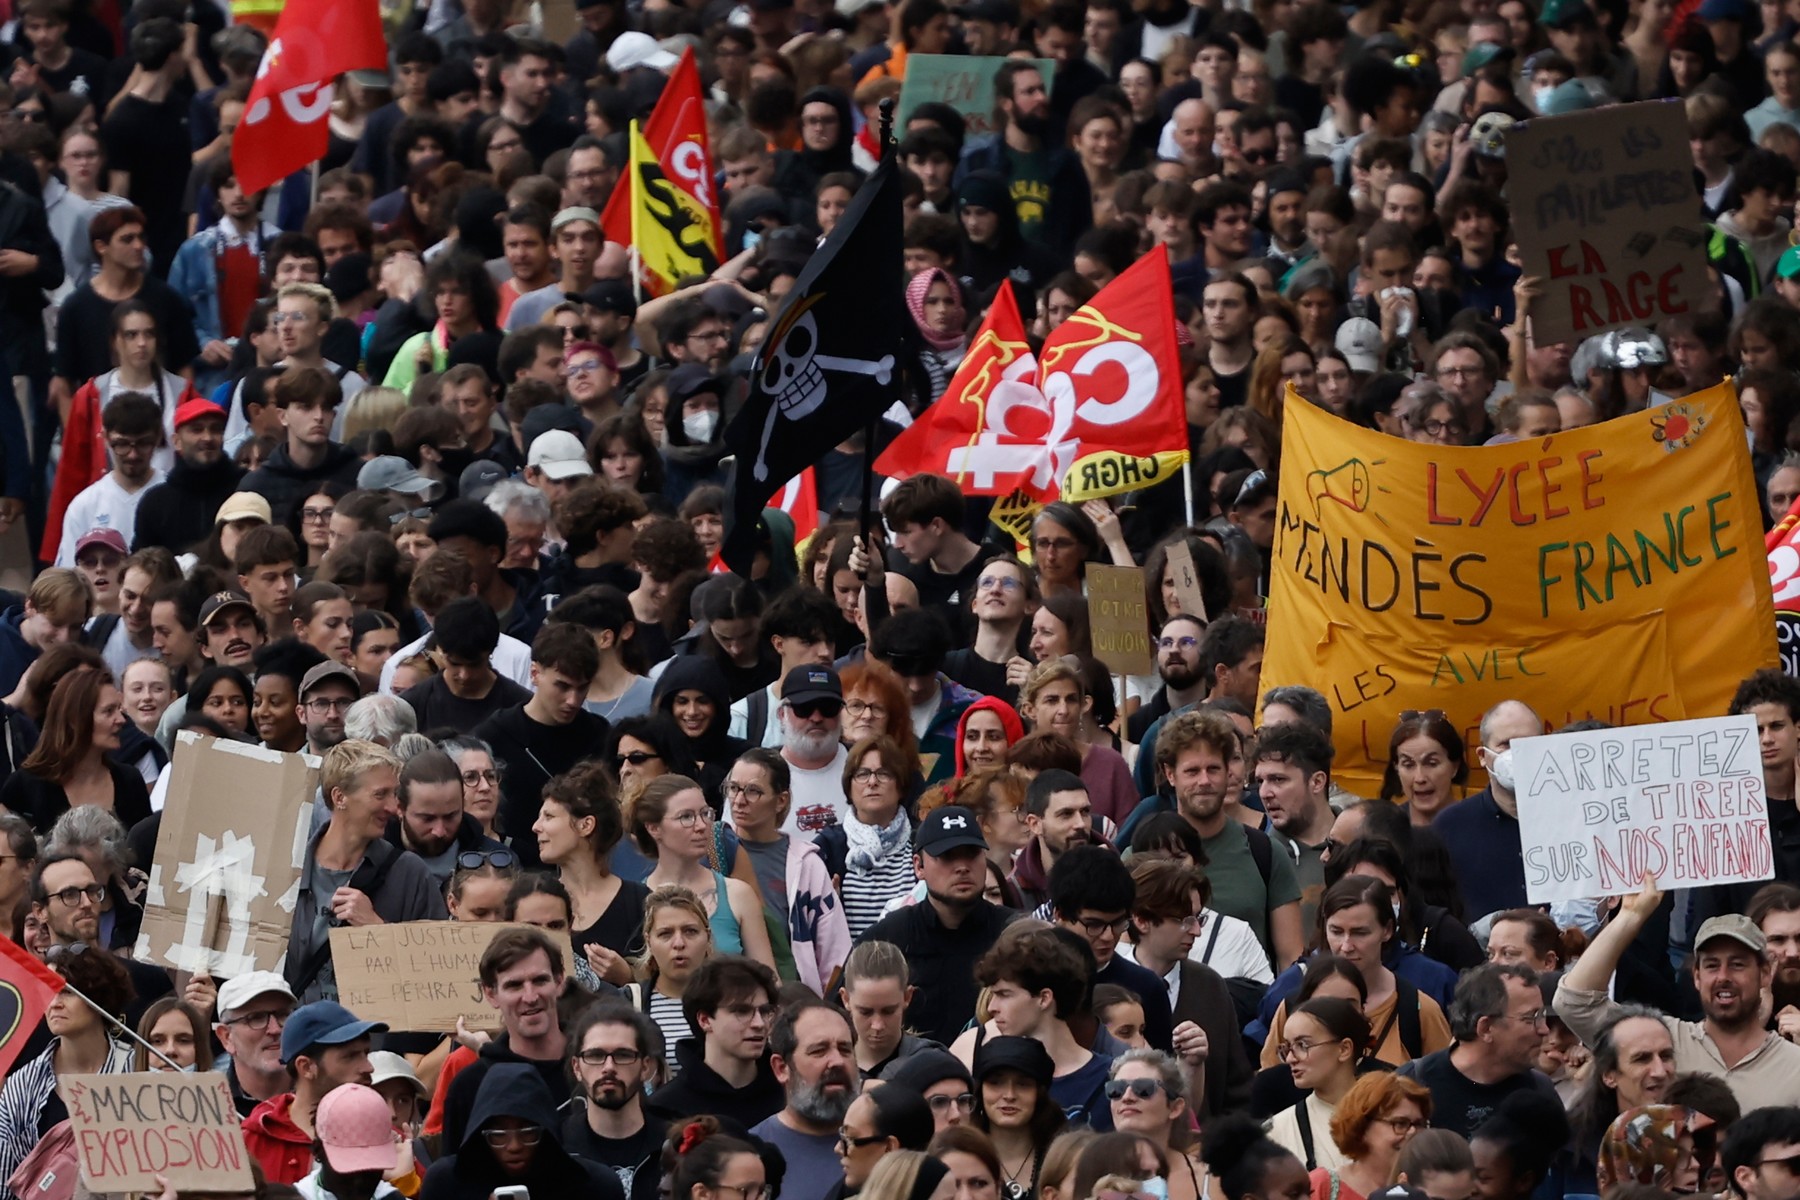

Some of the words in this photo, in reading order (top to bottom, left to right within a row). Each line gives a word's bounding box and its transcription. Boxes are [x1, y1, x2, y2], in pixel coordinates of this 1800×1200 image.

[1547, 239, 1607, 280] LA
[1570, 263, 1689, 331] RAGE
[1427, 437, 1605, 527] LYCÉE
[1280, 500, 1493, 626] MENDÈS
[1539, 491, 1738, 618] FRANCE
[1333, 664, 1397, 712] LES
[1431, 647, 1546, 687] AVEC
[1528, 728, 1750, 797] ARRETEZ
[1583, 796, 1630, 825] DE
[1642, 776, 1763, 819] TIRER
[1525, 841, 1593, 886] SUR
[1593, 825, 1668, 890] NOS
[1673, 819, 1771, 880] ENFANTS
[348, 930, 380, 950] LA
[399, 926, 482, 947] JUSTICE
[366, 956, 397, 973] PAR
[410, 951, 481, 972] L'HUMA
[350, 988, 376, 1006] NE
[392, 980, 458, 1002] PÉRIRA
[90, 1084, 224, 1126] MACRON
